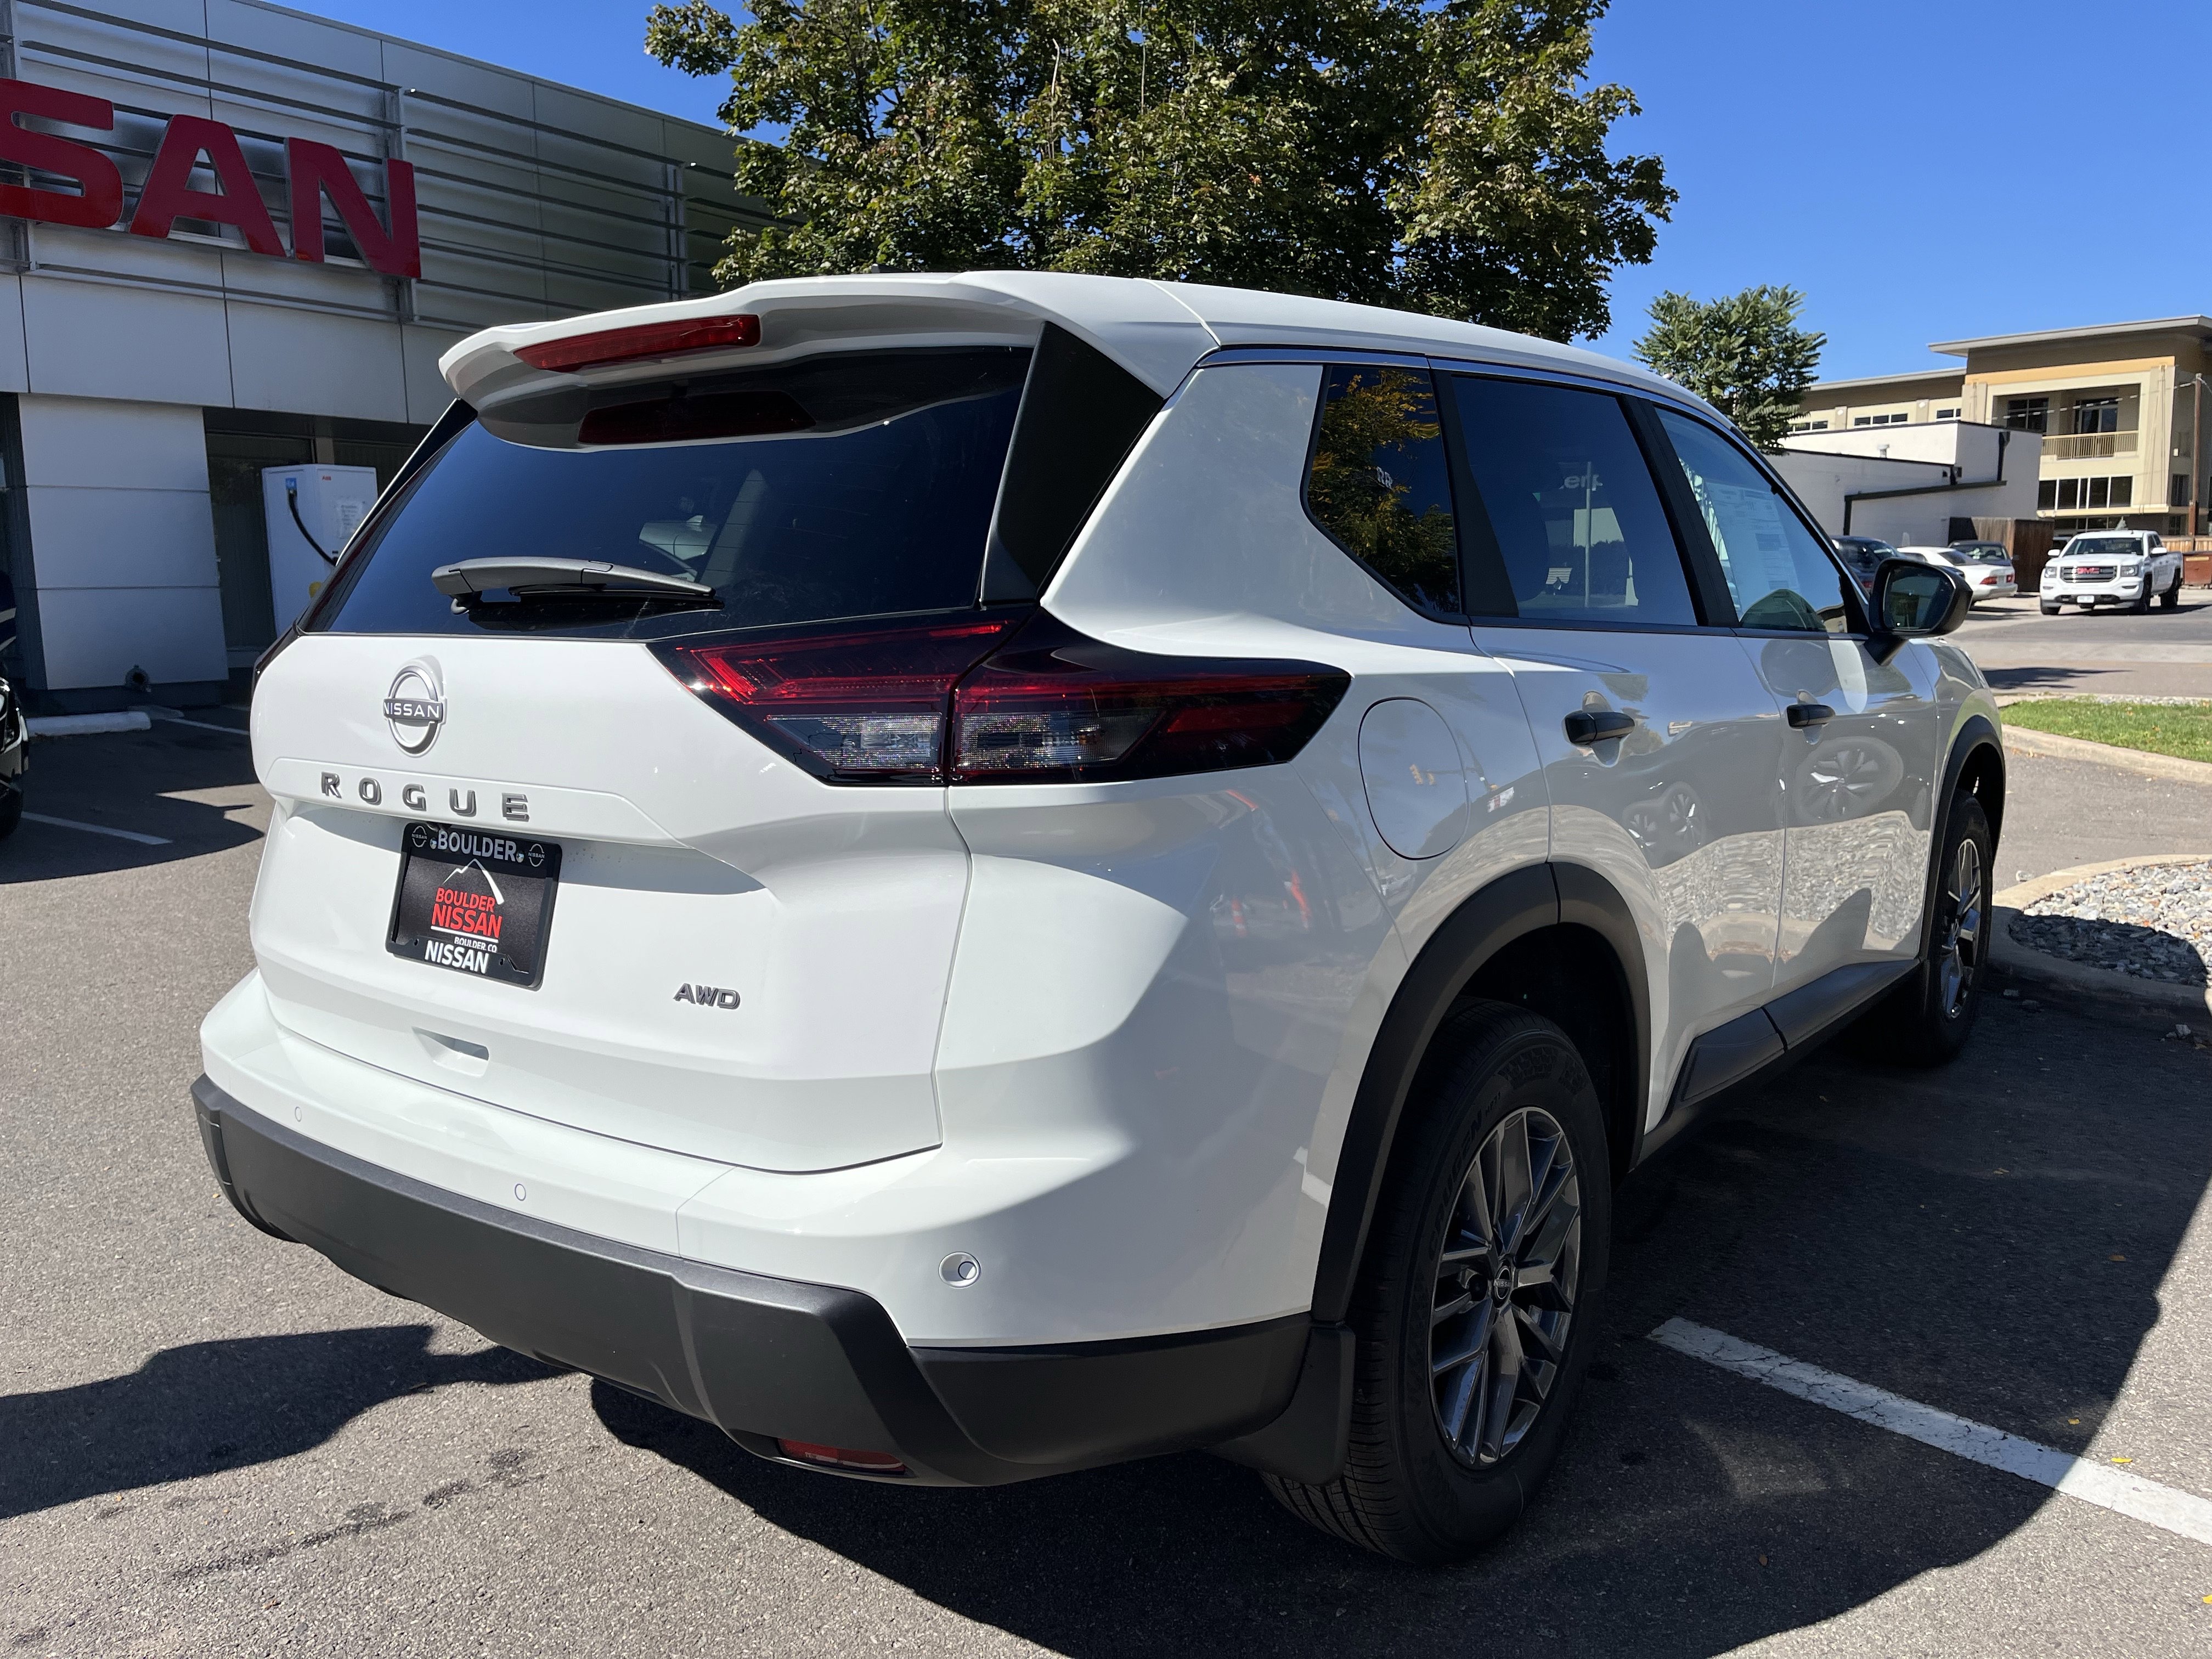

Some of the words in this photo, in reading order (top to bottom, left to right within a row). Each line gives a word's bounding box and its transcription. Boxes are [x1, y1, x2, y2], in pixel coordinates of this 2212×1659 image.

[383, 702, 439, 718] NISSAN
[321, 771, 530, 822] ROGUE
[438, 828, 517, 862] BOULDER
[436, 887, 495, 913] BOULDER
[431, 903, 503, 939] NISSAN
[425, 940, 489, 974] NISSAN
[487, 944, 497, 953] CO
[673, 983, 741, 1010] AWD
